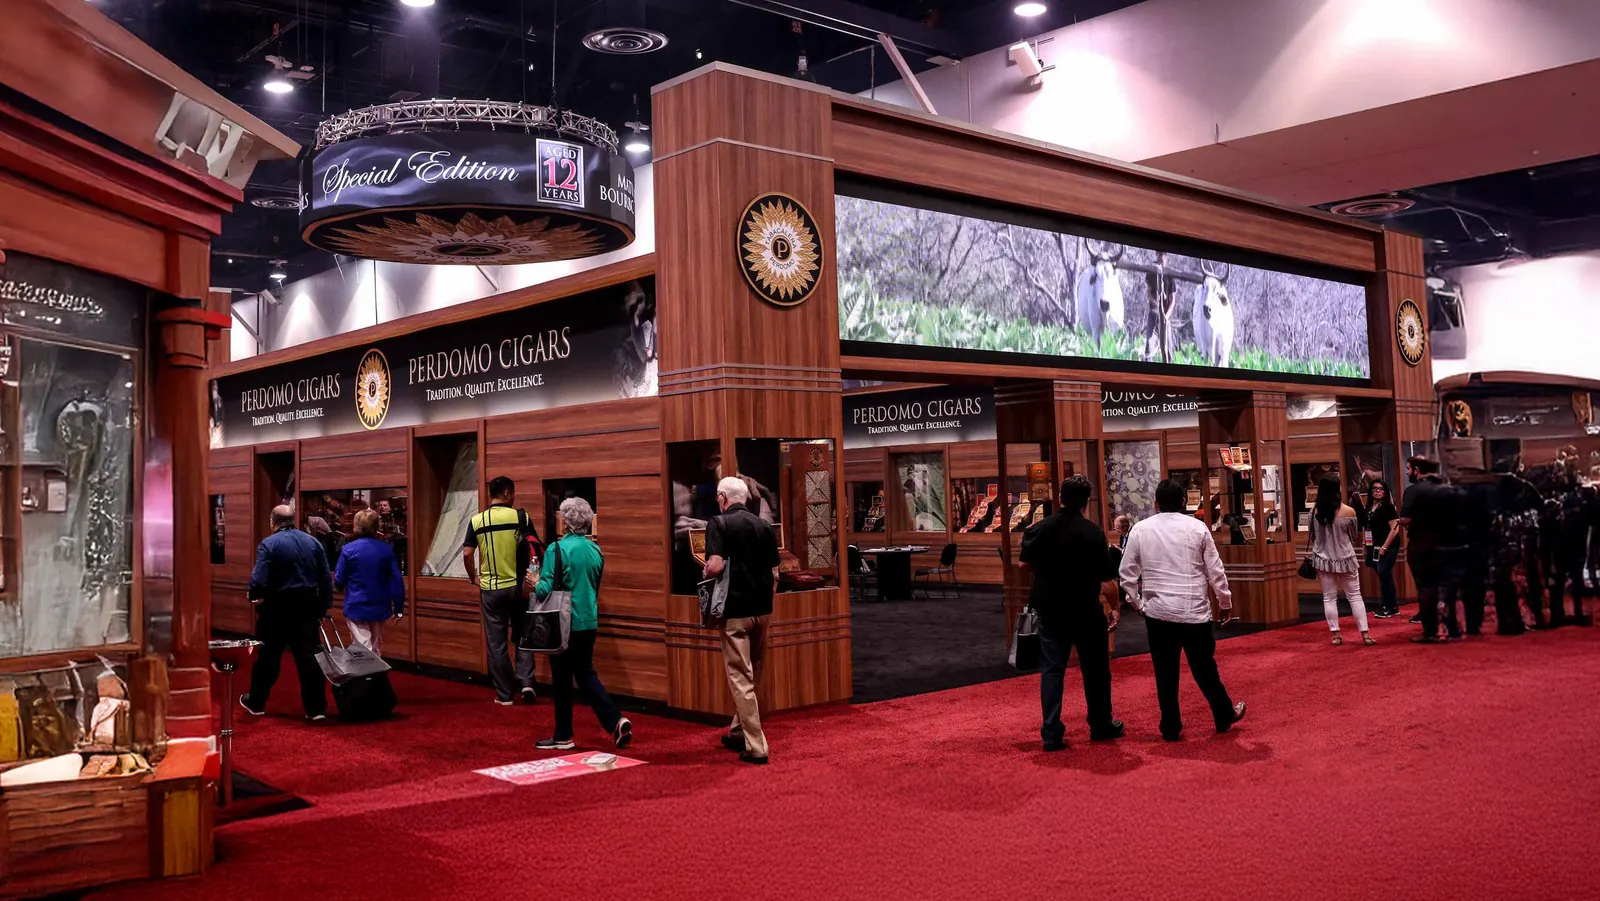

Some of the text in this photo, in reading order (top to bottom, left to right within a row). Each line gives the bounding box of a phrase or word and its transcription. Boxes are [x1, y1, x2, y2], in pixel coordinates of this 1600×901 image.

[545, 146, 576, 159] AGED
[323, 150, 519, 203] Special Edition
[543, 156, 577, 191] 12
[544, 187, 579, 202] YEARS
[765, 227, 797, 249] TABACALERA
[776, 240, 788, 258] P
[769, 256, 795, 270] PERDOMO
[408, 326, 571, 385] PERDOMO CIGARS
[241, 382, 294, 413] PERDOMO
[297, 373, 341, 403] CIGARS
[426, 373, 545, 402] TRADITION. QUALITY. EXCELLENCE.
[853, 397, 982, 425] PERDOMO CIGARS
[1101, 408, 1126, 417] ITION.
[1127, 405, 1161, 417] QUALITY.
[868, 420, 962, 435] TRADITION. QUALITY. EXCELLENCE.
